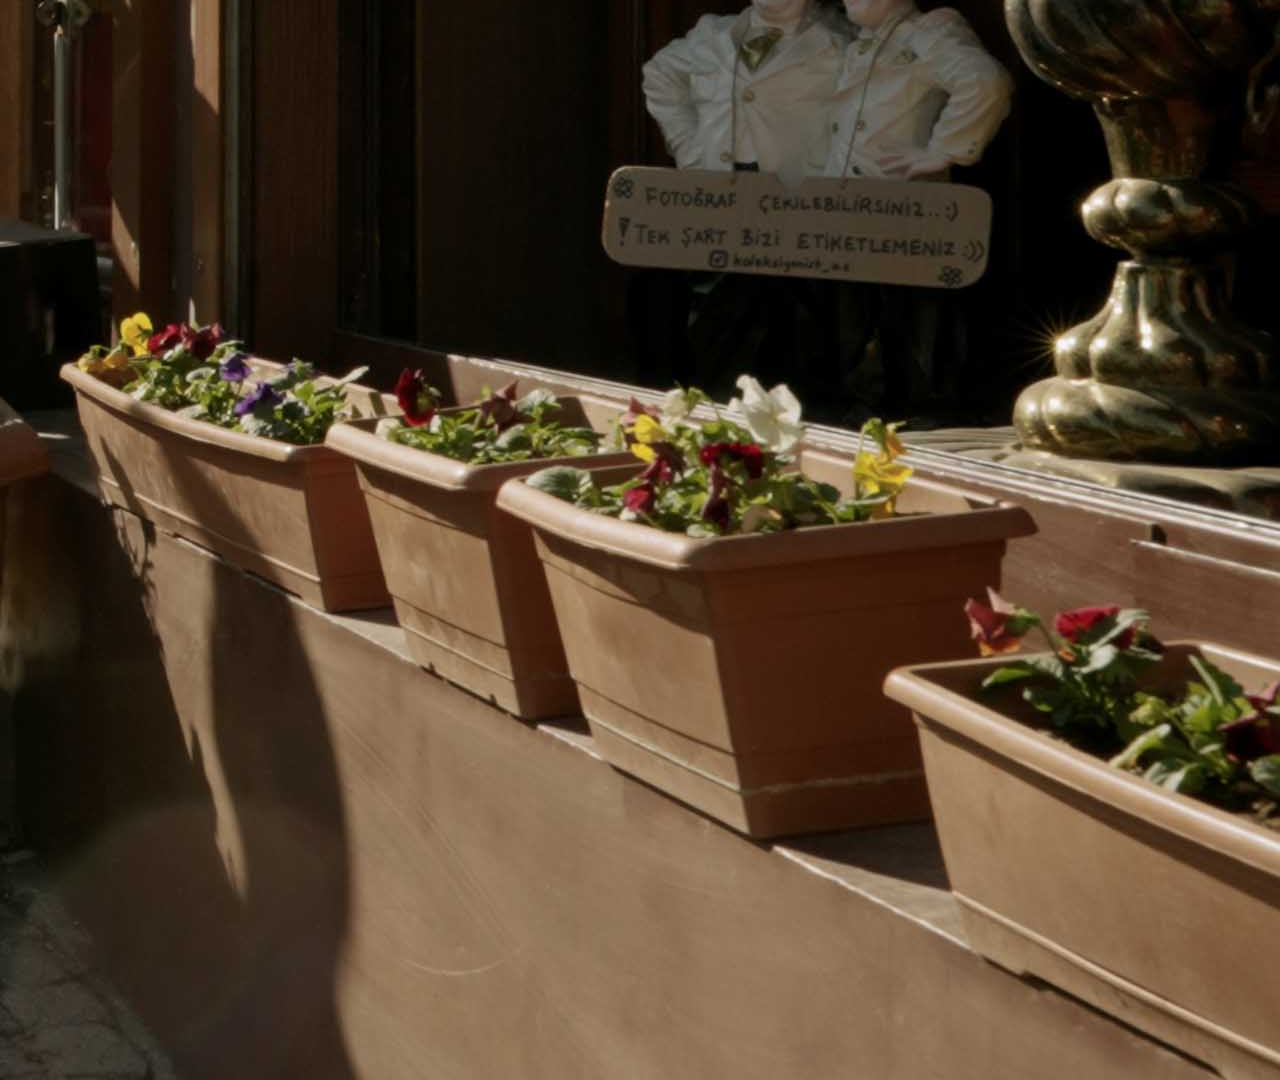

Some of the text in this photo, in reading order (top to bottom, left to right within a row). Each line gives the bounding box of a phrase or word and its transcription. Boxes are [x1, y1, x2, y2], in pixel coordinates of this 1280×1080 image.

[646, 186, 737, 208] FOTOĞRAF
[633, 224, 671, 245] TEK
[681, 227, 728, 248] ŞART
